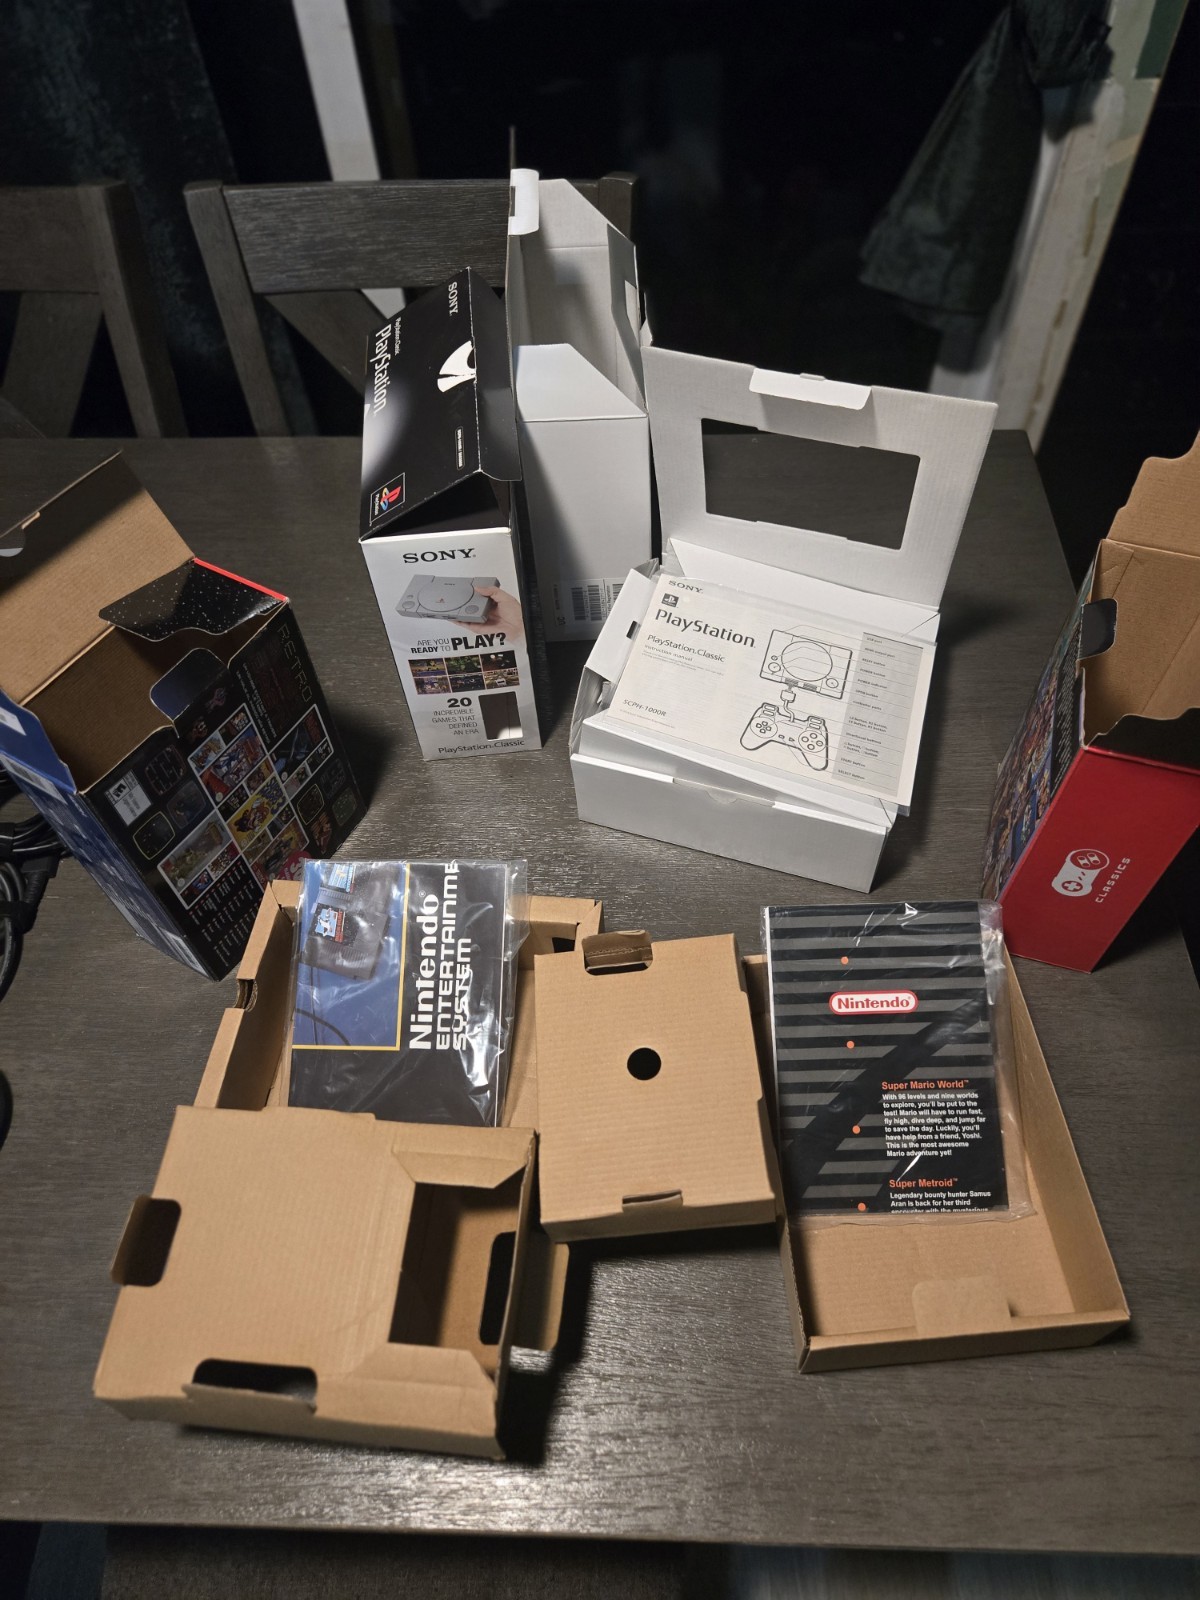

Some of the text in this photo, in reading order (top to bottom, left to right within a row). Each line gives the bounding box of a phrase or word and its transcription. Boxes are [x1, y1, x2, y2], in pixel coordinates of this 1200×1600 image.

[448, 282, 458, 315] SONY
[370, 324, 392, 413] PlayStation
[402, 548, 475, 564] SONY
[668, 580, 703, 594] SONY
[655, 608, 756, 648] PlayStation
[411, 646, 438, 654] READY
[450, 632, 506, 650] PLAY?
[434, 638, 450, 646] YOU
[648, 634, 726, 662] PlayStation Classic
[278, 623, 312, 702] RETRO
[673, 652, 693, 662] manual
[447, 698, 472, 708] 20
[432, 716, 457, 724] GAMES
[449, 722, 478, 730] DEFINED
[438, 740, 525, 754] PlayStation Classic
[1095, 858, 1130, 903] CLASSICS
[452, 938, 472, 1050] SYSTEM
[838, 996, 910, 1009] Nintendo
[882, 1082, 908, 1090] Super
[910, 1081, 935, 1089] Mario
[918, 1101, 935, 1109] you'll
[889, 1180, 916, 1189] Super
